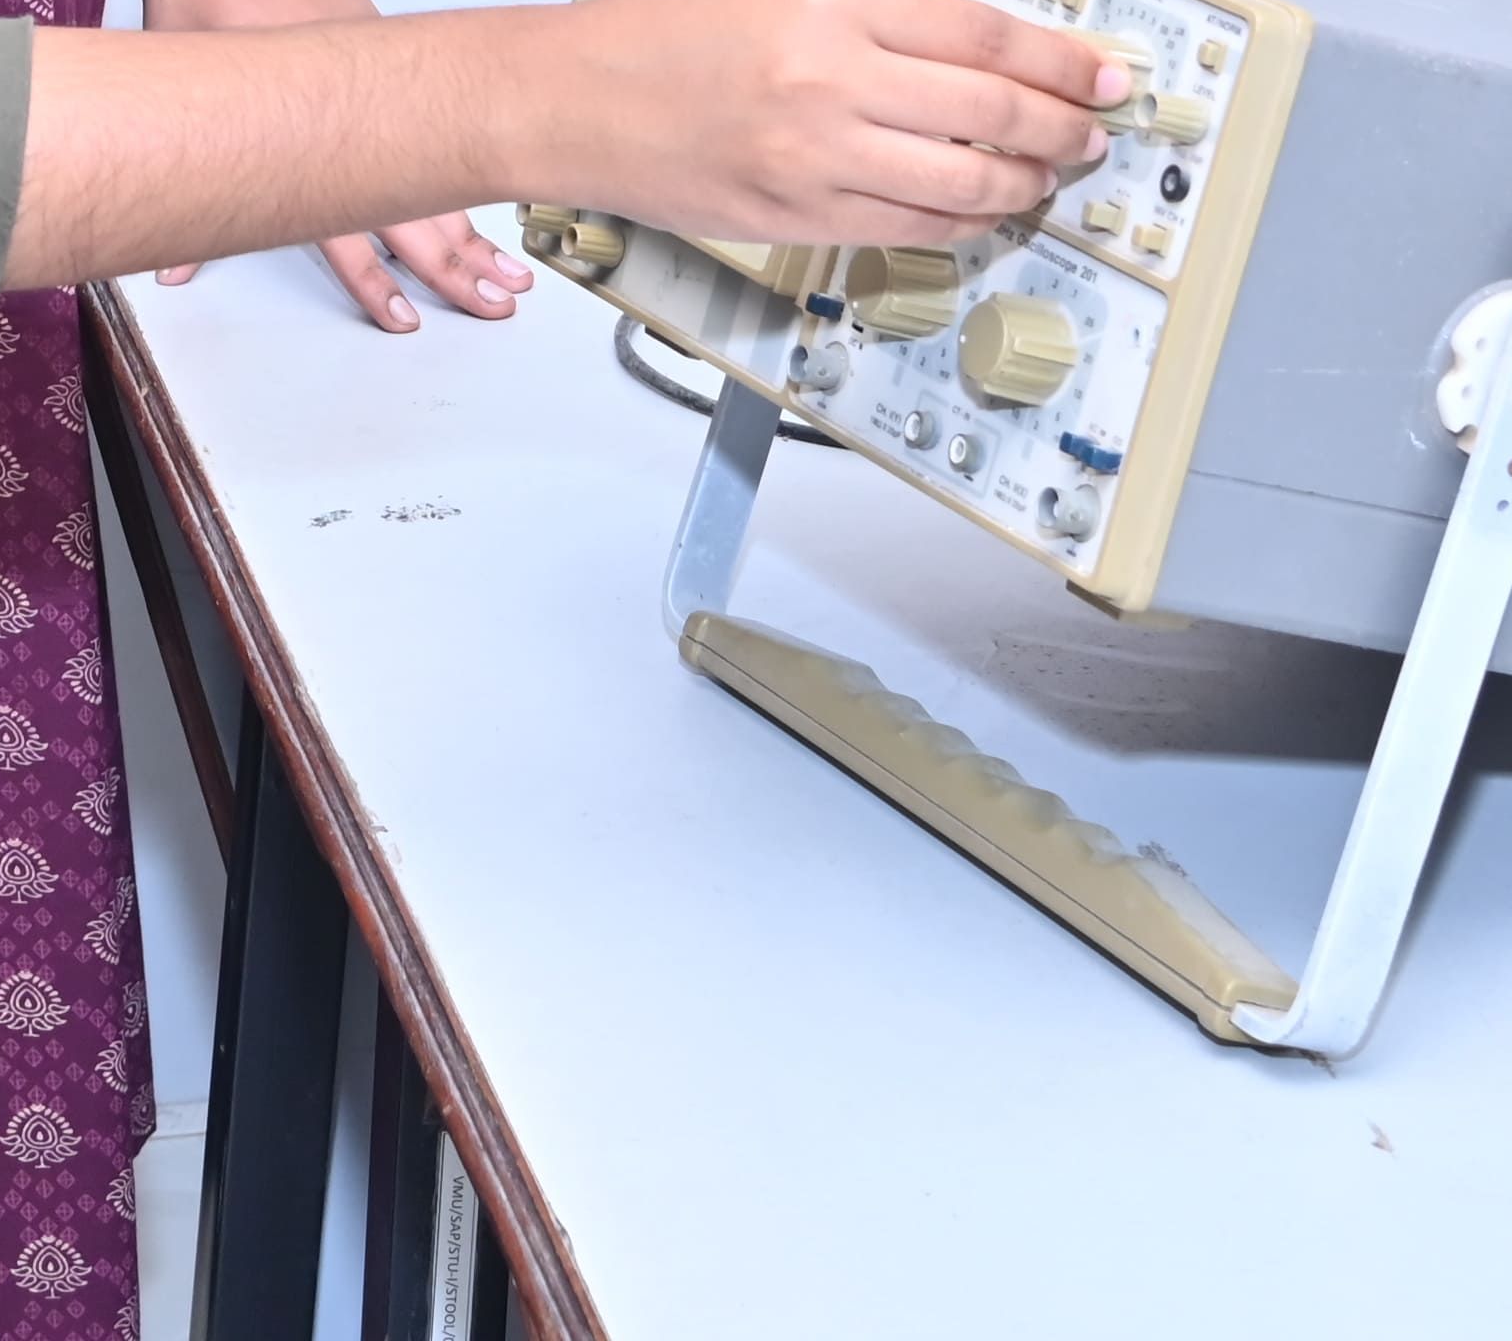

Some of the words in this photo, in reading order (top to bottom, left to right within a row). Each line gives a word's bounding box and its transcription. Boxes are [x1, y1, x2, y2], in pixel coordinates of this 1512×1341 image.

[1193, 83, 1215, 101] LEVEL
[1017, 232, 1078, 274] Oscilloscope
[1080, 266, 1098, 284] 201
